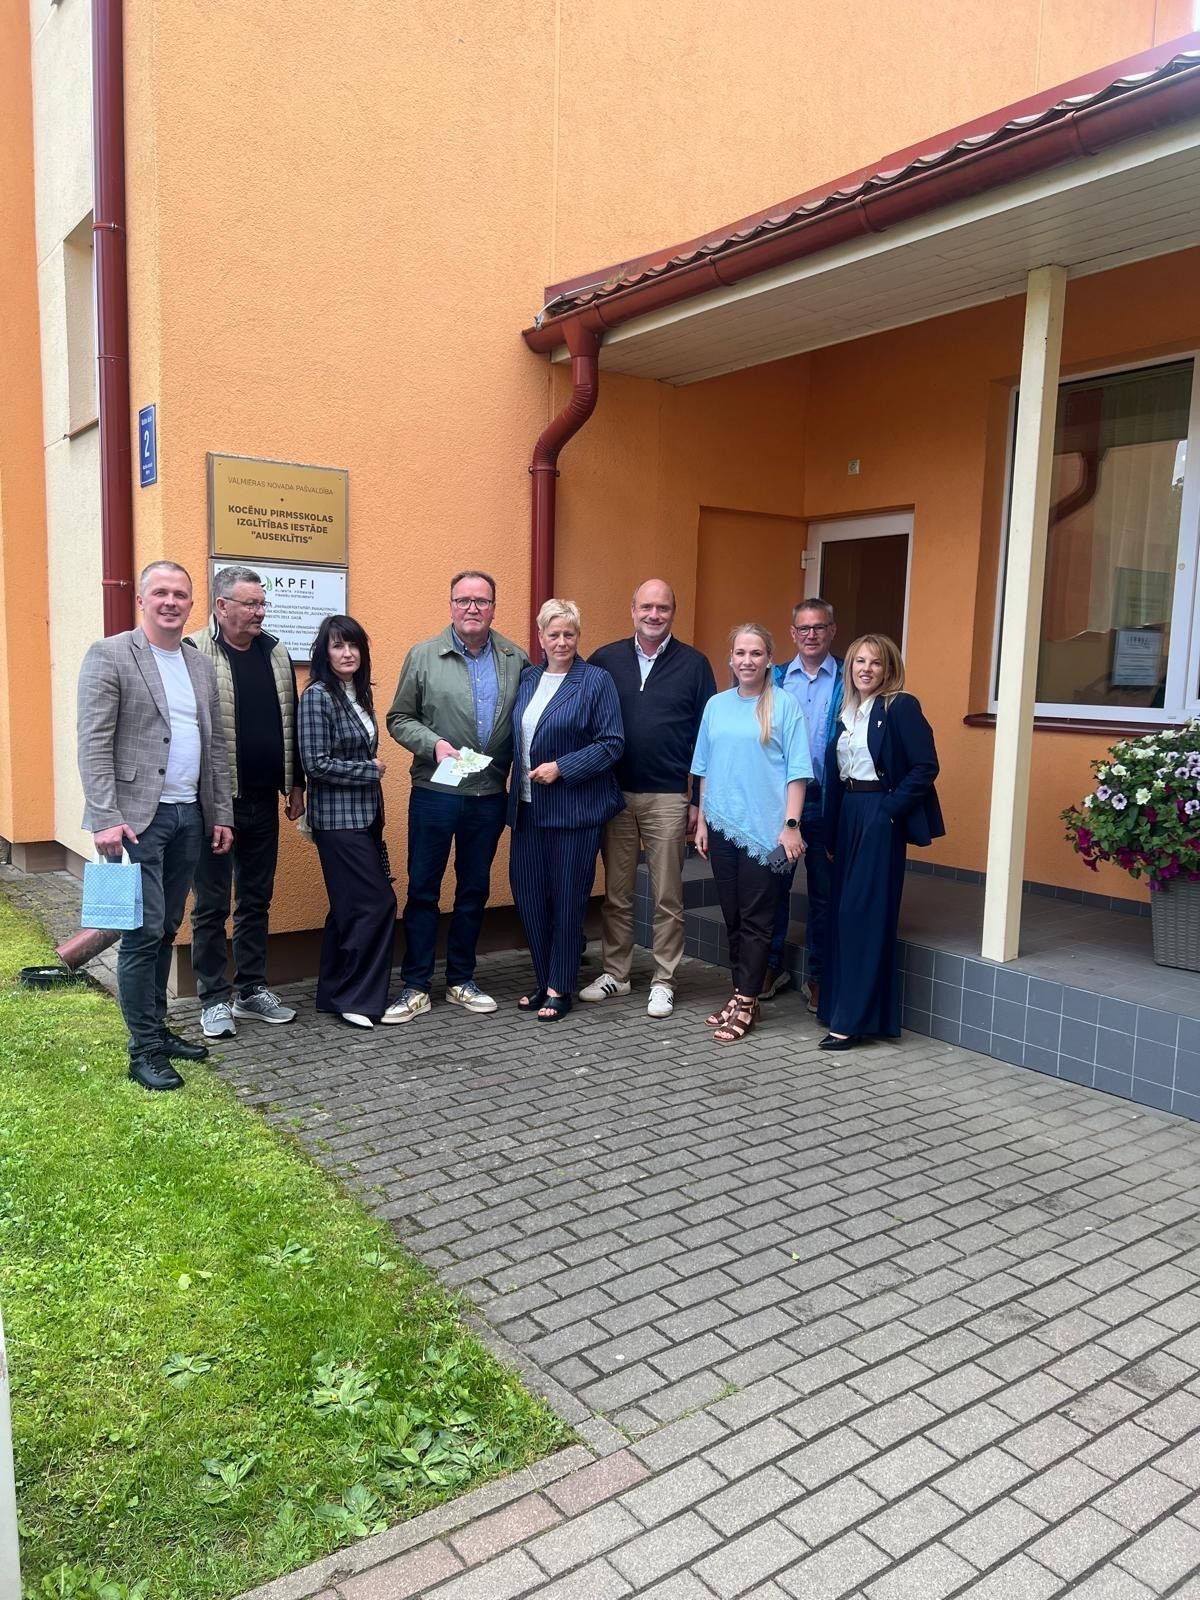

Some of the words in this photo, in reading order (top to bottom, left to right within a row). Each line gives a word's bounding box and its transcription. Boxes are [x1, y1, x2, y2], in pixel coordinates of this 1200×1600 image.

[144, 430, 150, 458] 2
[228, 476, 266, 488] VALMIERAS
[267, 482, 294, 491] NOVADA
[295, 485, 334, 495] PAŠVALDĪBA
[228, 504, 268, 516] KOCĒNU
[270, 509, 334, 523] PIRMSSKOLAS
[236, 518, 289, 530] IZGLĪTĪBAS
[291, 523, 328, 534] IESTĀDE
[275, 577, 314, 589] KPFI
